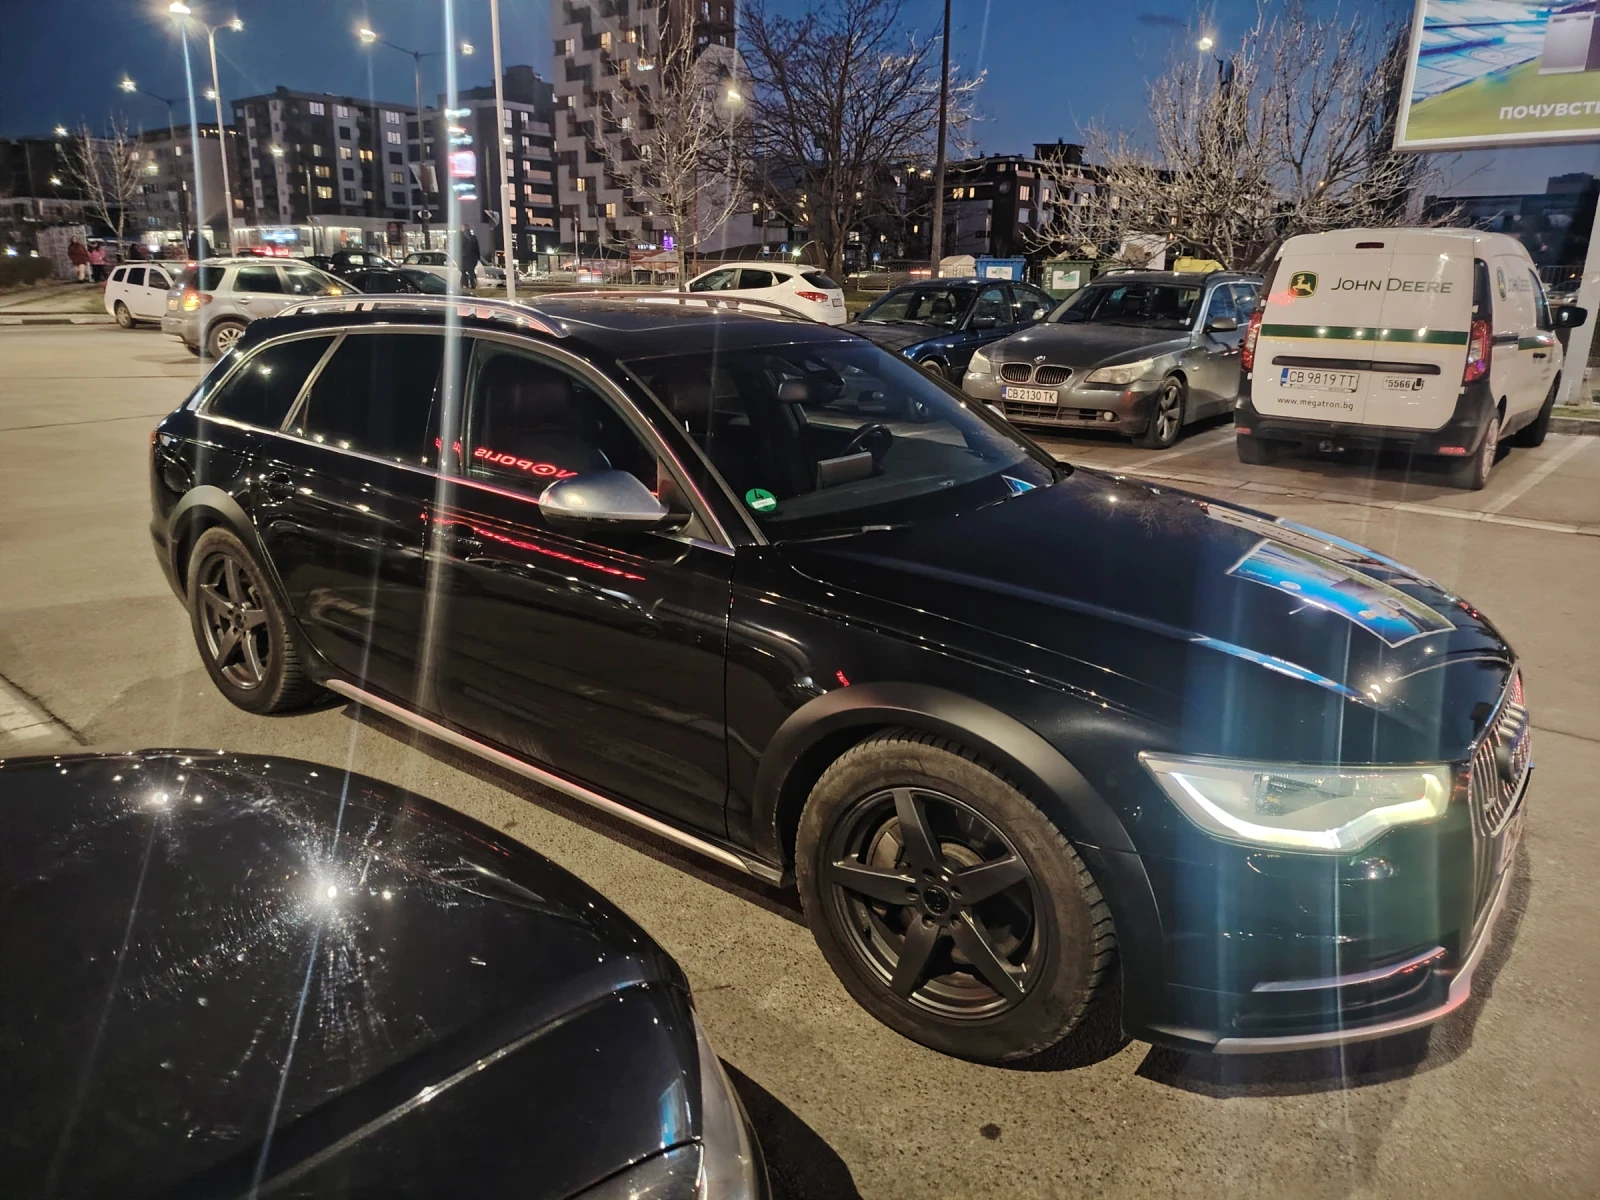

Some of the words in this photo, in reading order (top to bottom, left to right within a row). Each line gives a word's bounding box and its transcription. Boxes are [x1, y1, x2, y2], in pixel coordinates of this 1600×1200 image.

[1331, 277, 1382, 291] JOHN
[1386, 278, 1453, 294] DEERE
[1289, 371, 1304, 383] CB
[1307, 372, 1337, 386] 9819
[1340, 374, 1355, 387] TT
[1007, 388, 1018, 399] CB
[1020, 389, 1041, 401] 2130
[1043, 391, 1055, 402] TK
[1277, 397, 1354, 411] www.megatron.bg
